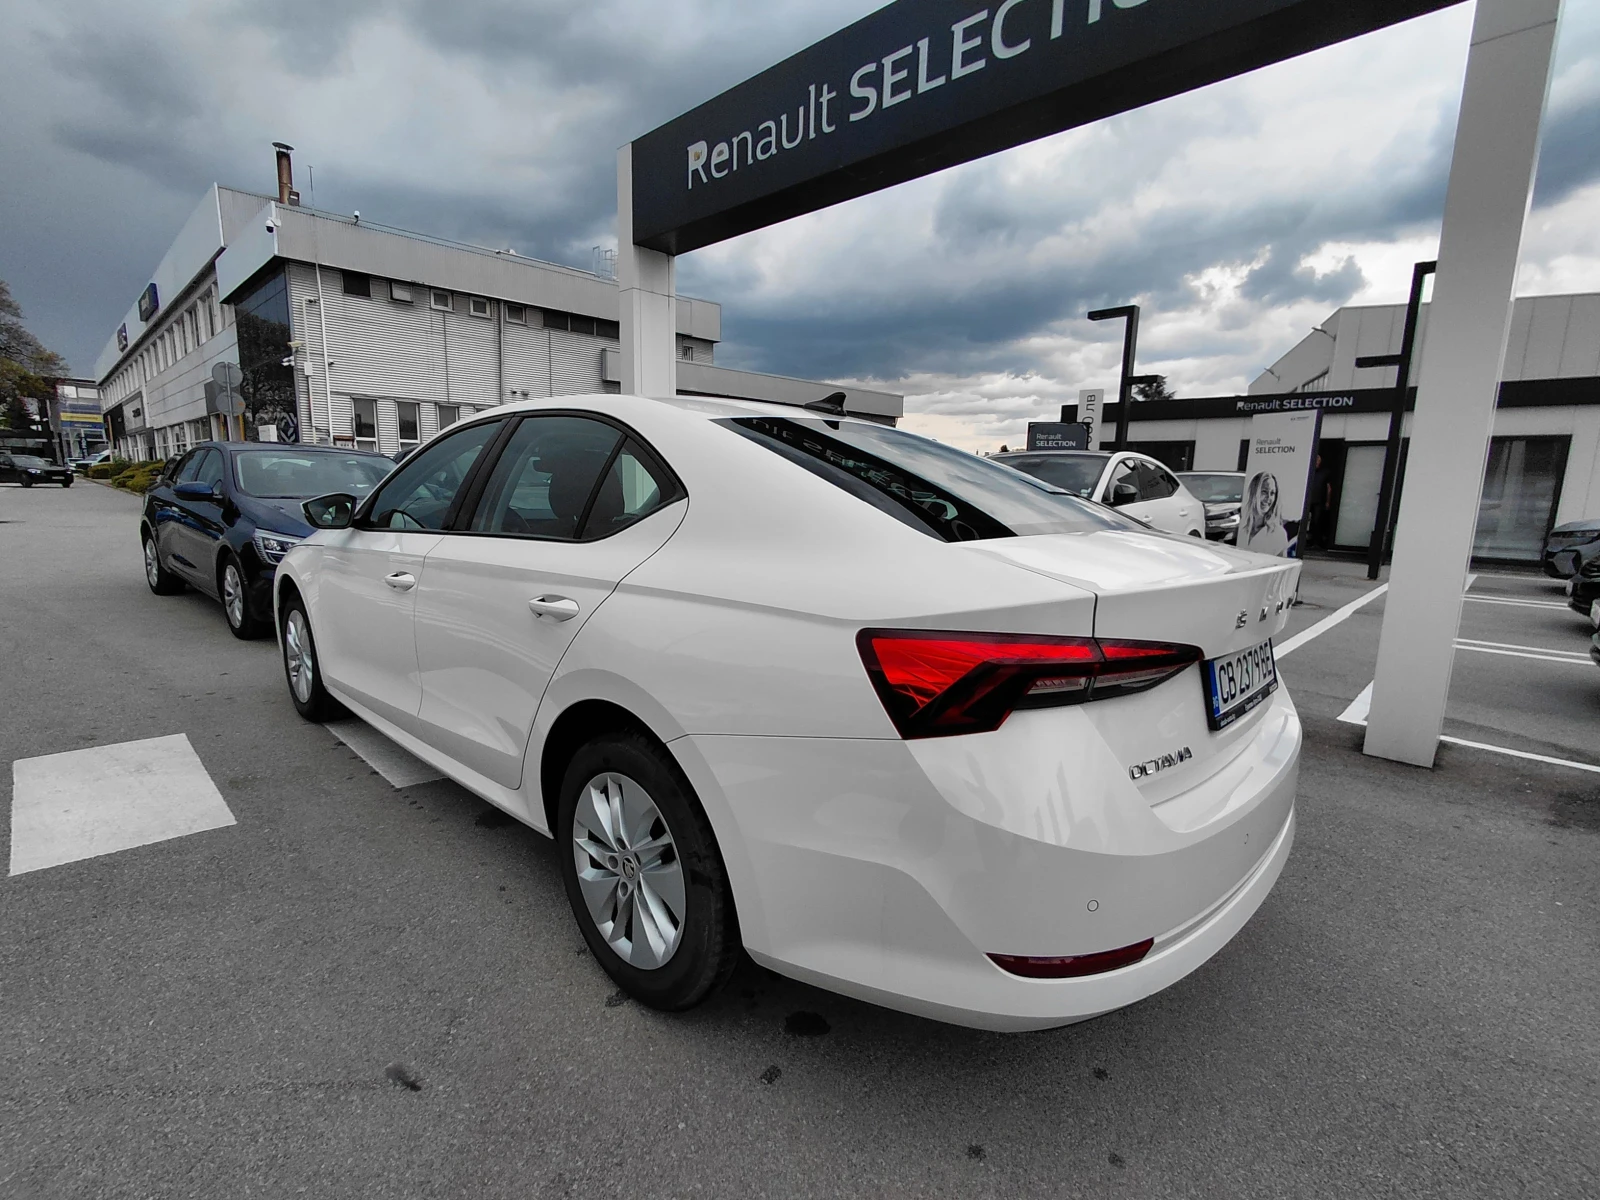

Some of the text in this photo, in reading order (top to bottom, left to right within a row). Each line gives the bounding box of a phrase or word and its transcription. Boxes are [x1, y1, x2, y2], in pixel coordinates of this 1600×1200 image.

[687, 83, 837, 190] Renault
[1236, 396, 1353, 411] Renault SELECTION
[1256, 437, 1281, 446] Renault
[1255, 445, 1295, 454] SELECTION
[1128, 746, 1192, 780] OCTAVIA
